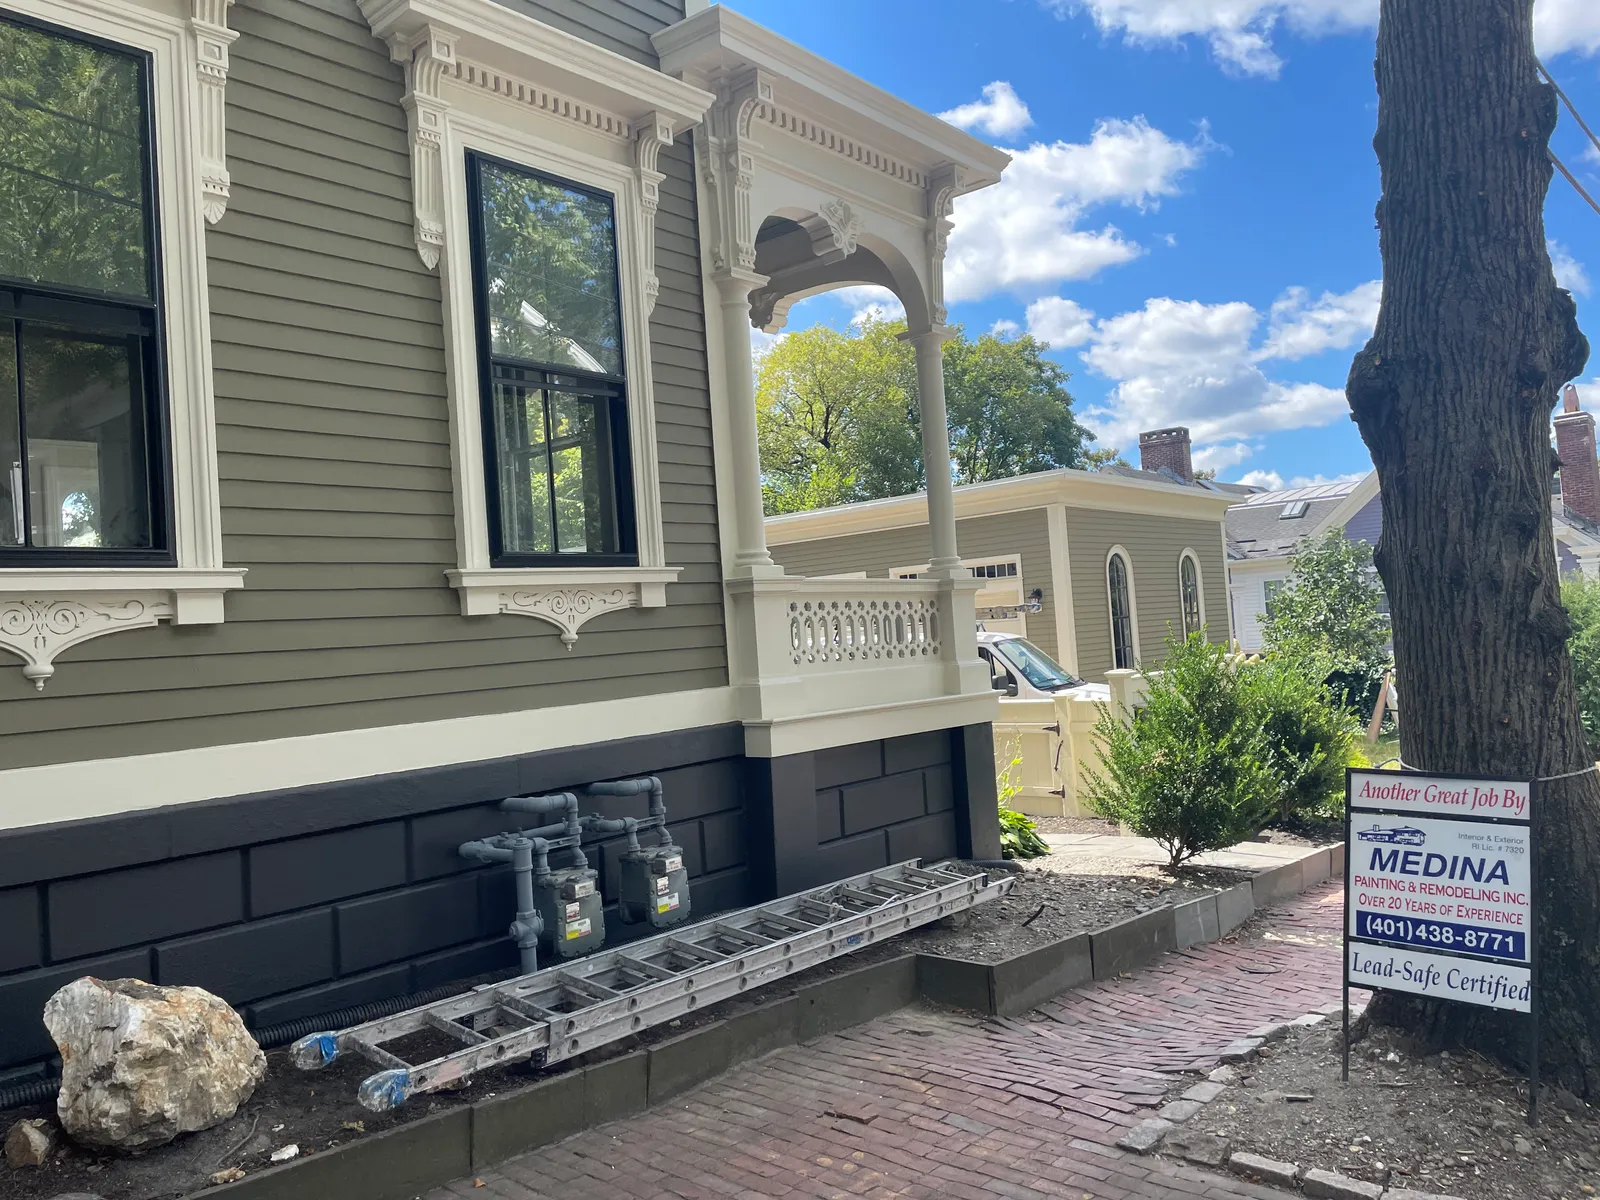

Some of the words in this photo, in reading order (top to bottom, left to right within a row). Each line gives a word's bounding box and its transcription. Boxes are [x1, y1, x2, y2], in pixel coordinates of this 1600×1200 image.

[1359, 780, 1421, 801] Another
[1424, 784, 1469, 805] Great
[1471, 787, 1499, 811] Job
[1502, 789, 1526, 816] By
[1458, 833, 1484, 841] Interior
[1494, 836, 1524, 844] Exterior
[1482, 844, 1495, 852] Lic.
[1505, 846, 1525, 854] 7320
[1369, 847, 1510, 885] MEDINA
[1354, 875, 1406, 892] PAINTING
[1408, 883, 1417, 893] &
[1419, 883, 1500, 903] REMODELING
[1503, 892, 1529, 906] INC.
[1358, 893, 1385, 908] OVER
[1388, 896, 1402, 910] 20
[1405, 898, 1437, 915] YEARS
[1439, 904, 1453, 916] OF
[1456, 904, 1523, 926] EXPERIENCE
[1352, 952, 1441, 991] Lead-Safe
[1446, 968, 1531, 1003] Certified
